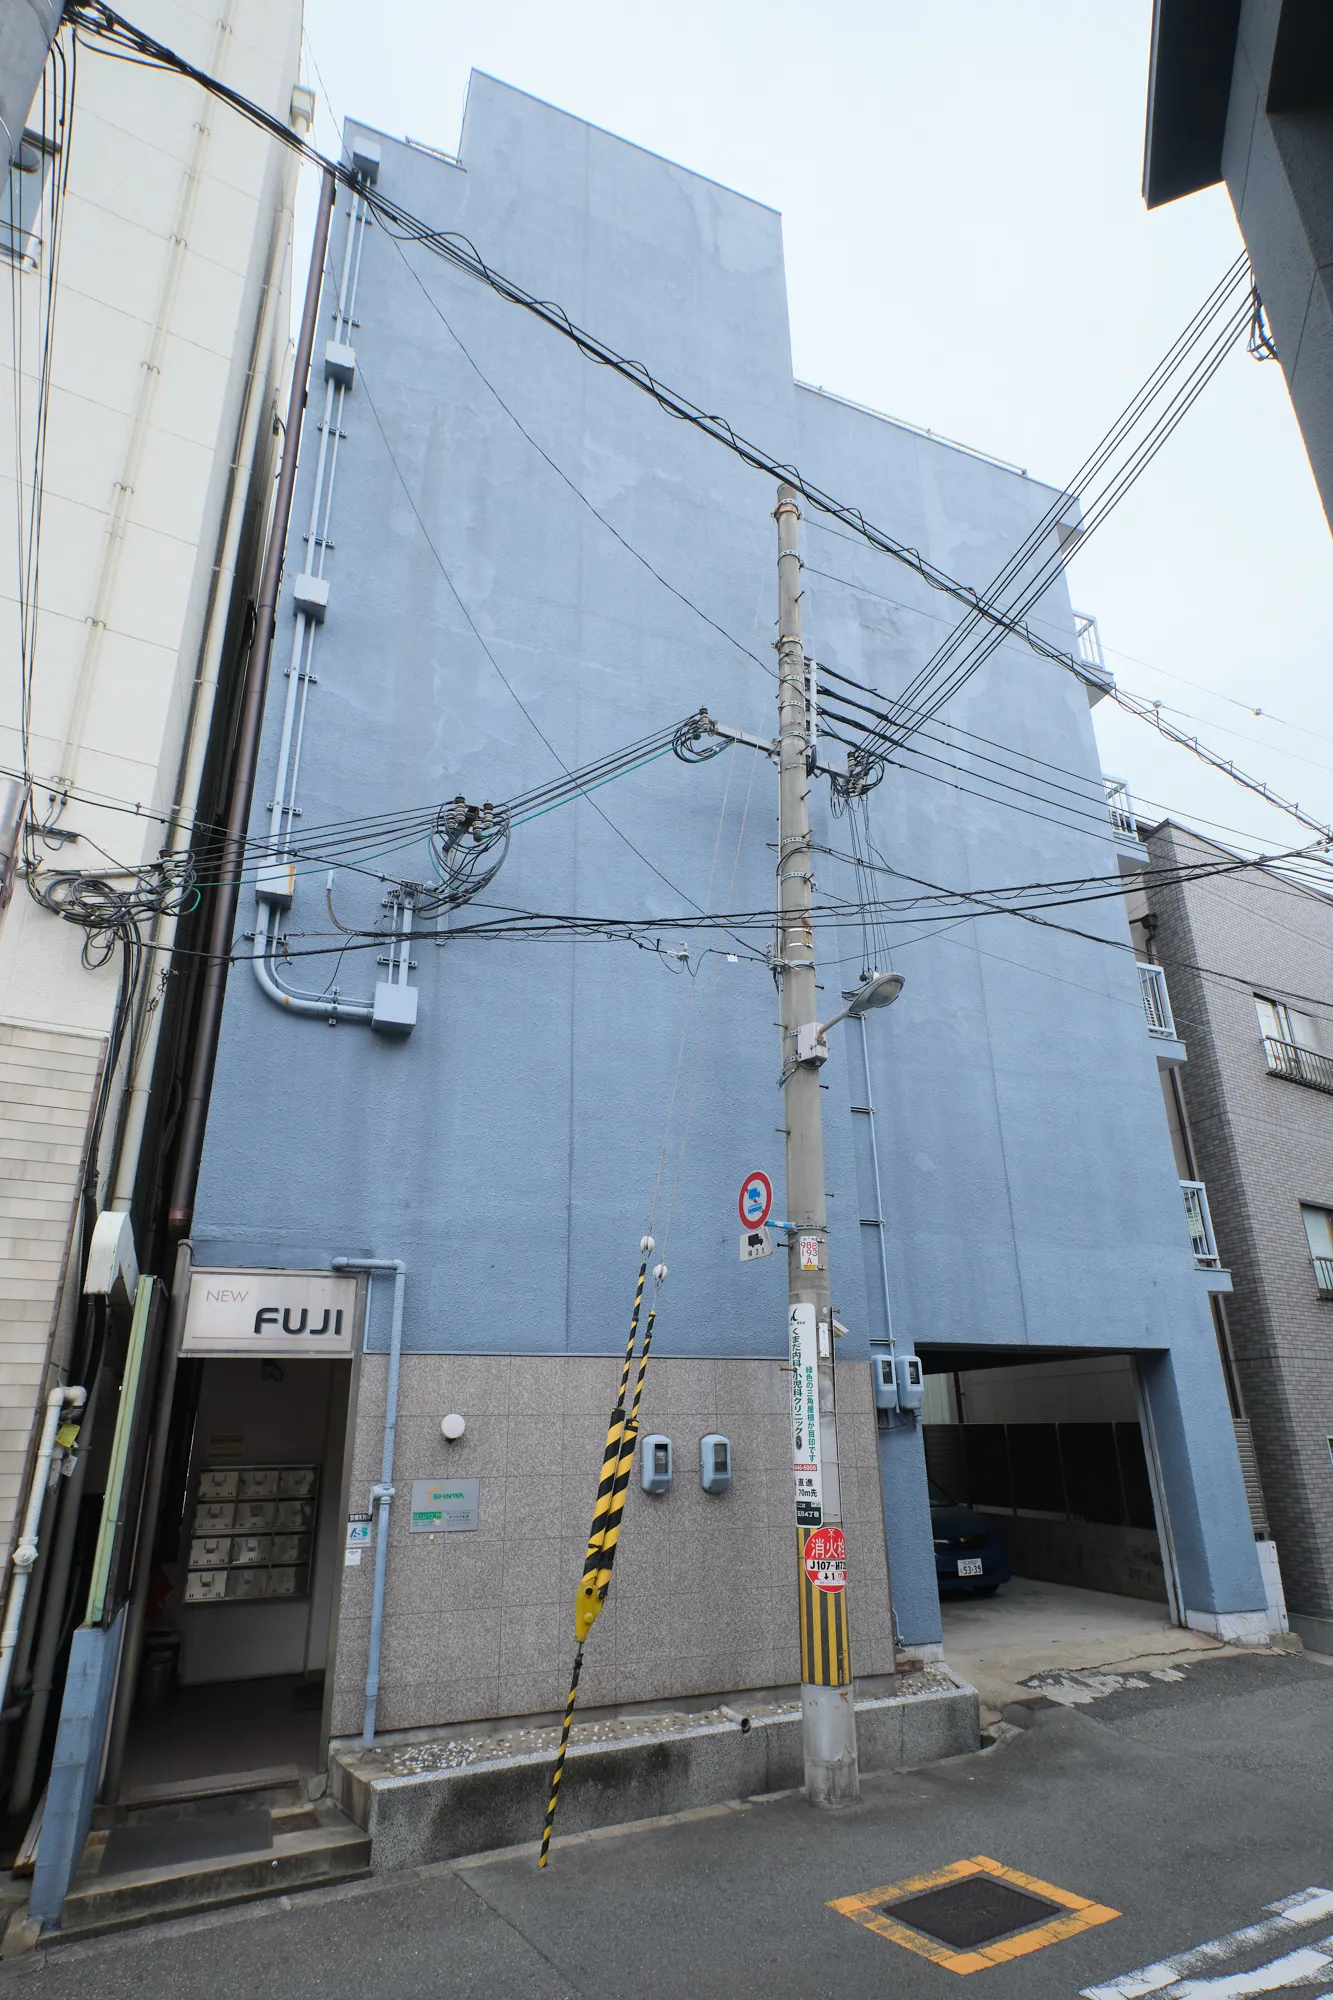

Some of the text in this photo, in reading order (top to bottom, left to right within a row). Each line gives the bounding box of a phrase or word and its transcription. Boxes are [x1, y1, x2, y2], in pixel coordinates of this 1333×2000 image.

[206, 1290, 249, 1303] NEW
[254, 1307, 343, 1336] FUJI
[811, 1537, 845, 1558] 消火栓
